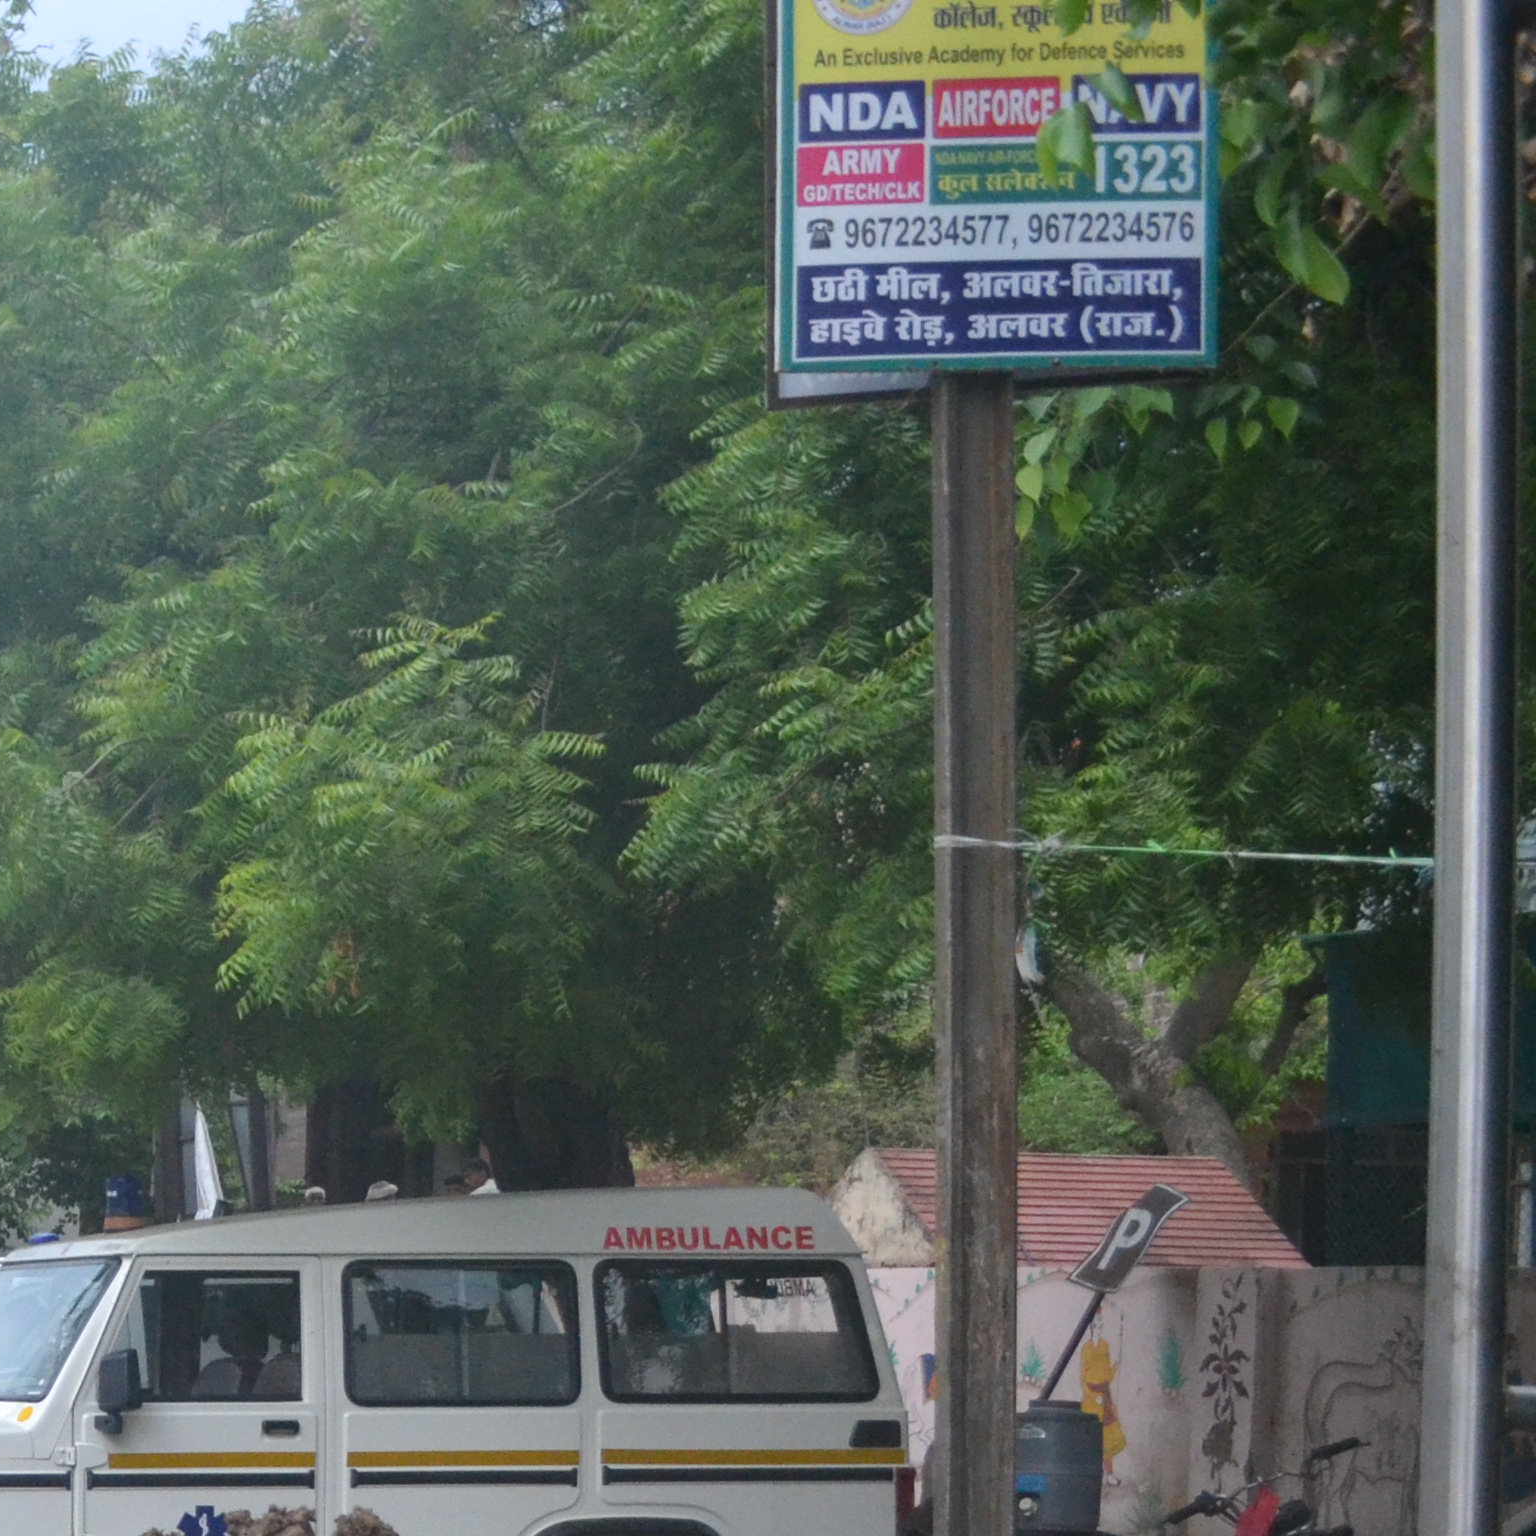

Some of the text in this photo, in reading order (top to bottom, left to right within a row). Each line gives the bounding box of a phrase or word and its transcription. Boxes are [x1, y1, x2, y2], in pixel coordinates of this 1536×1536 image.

[815, 39, 1184, 67] An Exclusive Academy for Defence Services
[809, 91, 917, 132] NDA
[938, 87, 1055, 127] AIRFORCE
[1079, 83, 1196, 124] NVY
[822, 148, 901, 175] ARMY
[1096, 144, 1196, 193] 1323
[803, 180, 921, 202] GD/TECH/CLK
[845, 212, 1195, 250] 9672234577, 9672234576
[875, 266, 950, 304] मील,
[963, 263, 1184, 301] अलवर-तिजारा,
[809, 309, 887, 345] हाइवे
[968, 313, 1069, 340] अलवर
[1080, 305, 1185, 344] (राज.)
[603, 1226, 816, 1250] AMBULANCE
[1096, 1208, 1152, 1270] P
